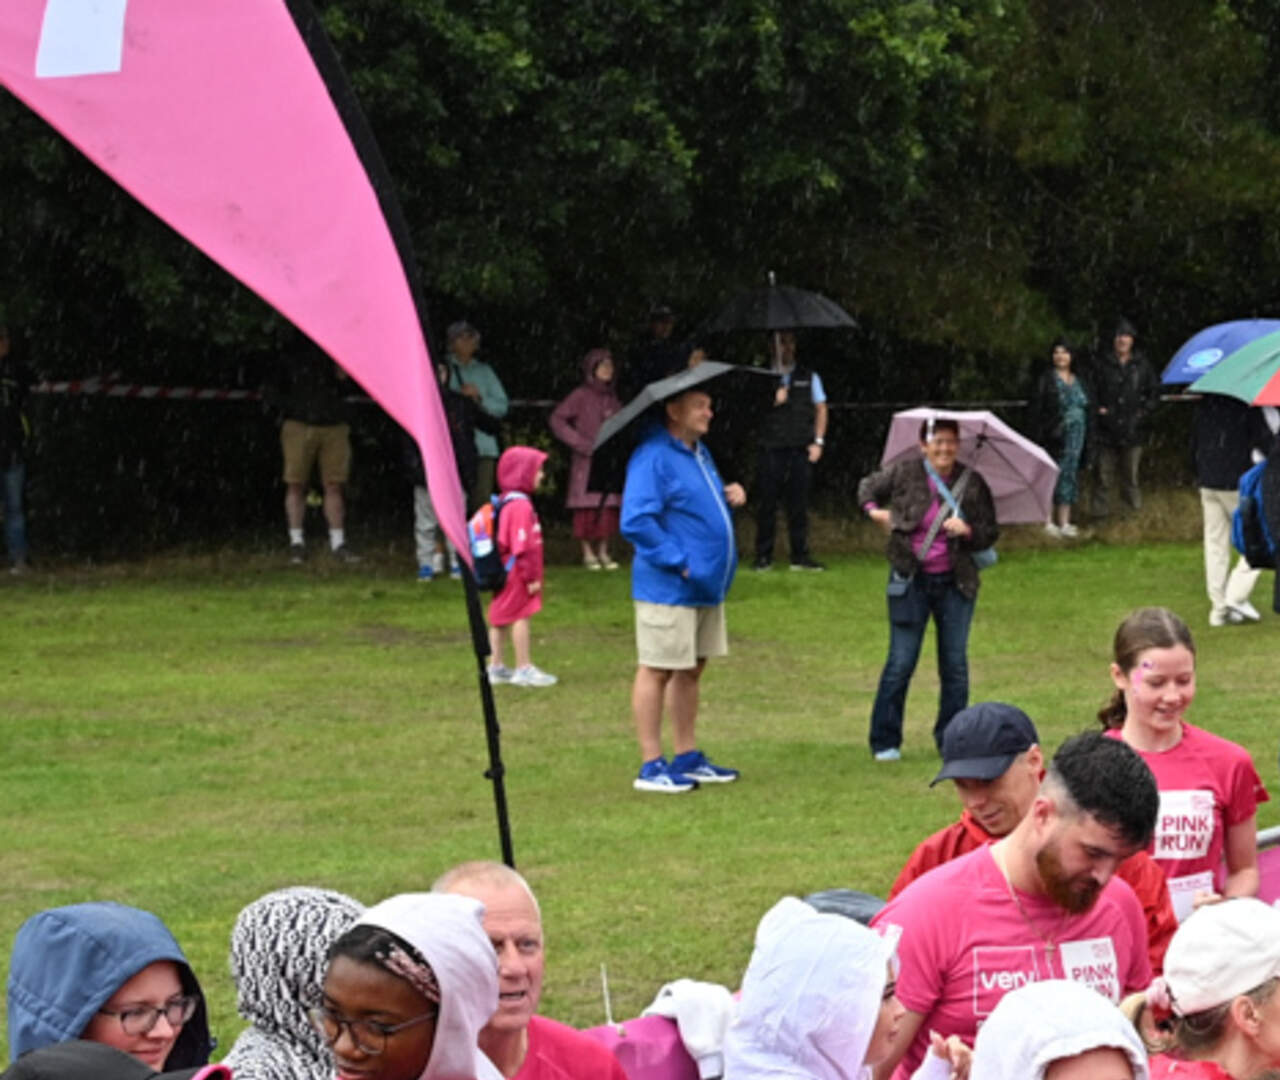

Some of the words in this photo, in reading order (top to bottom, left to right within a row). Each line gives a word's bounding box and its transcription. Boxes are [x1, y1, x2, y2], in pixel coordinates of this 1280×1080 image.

[1161, 815, 1209, 832] PINK
[1160, 833, 1205, 850] RUN
[1071, 962, 1114, 981] PINK
